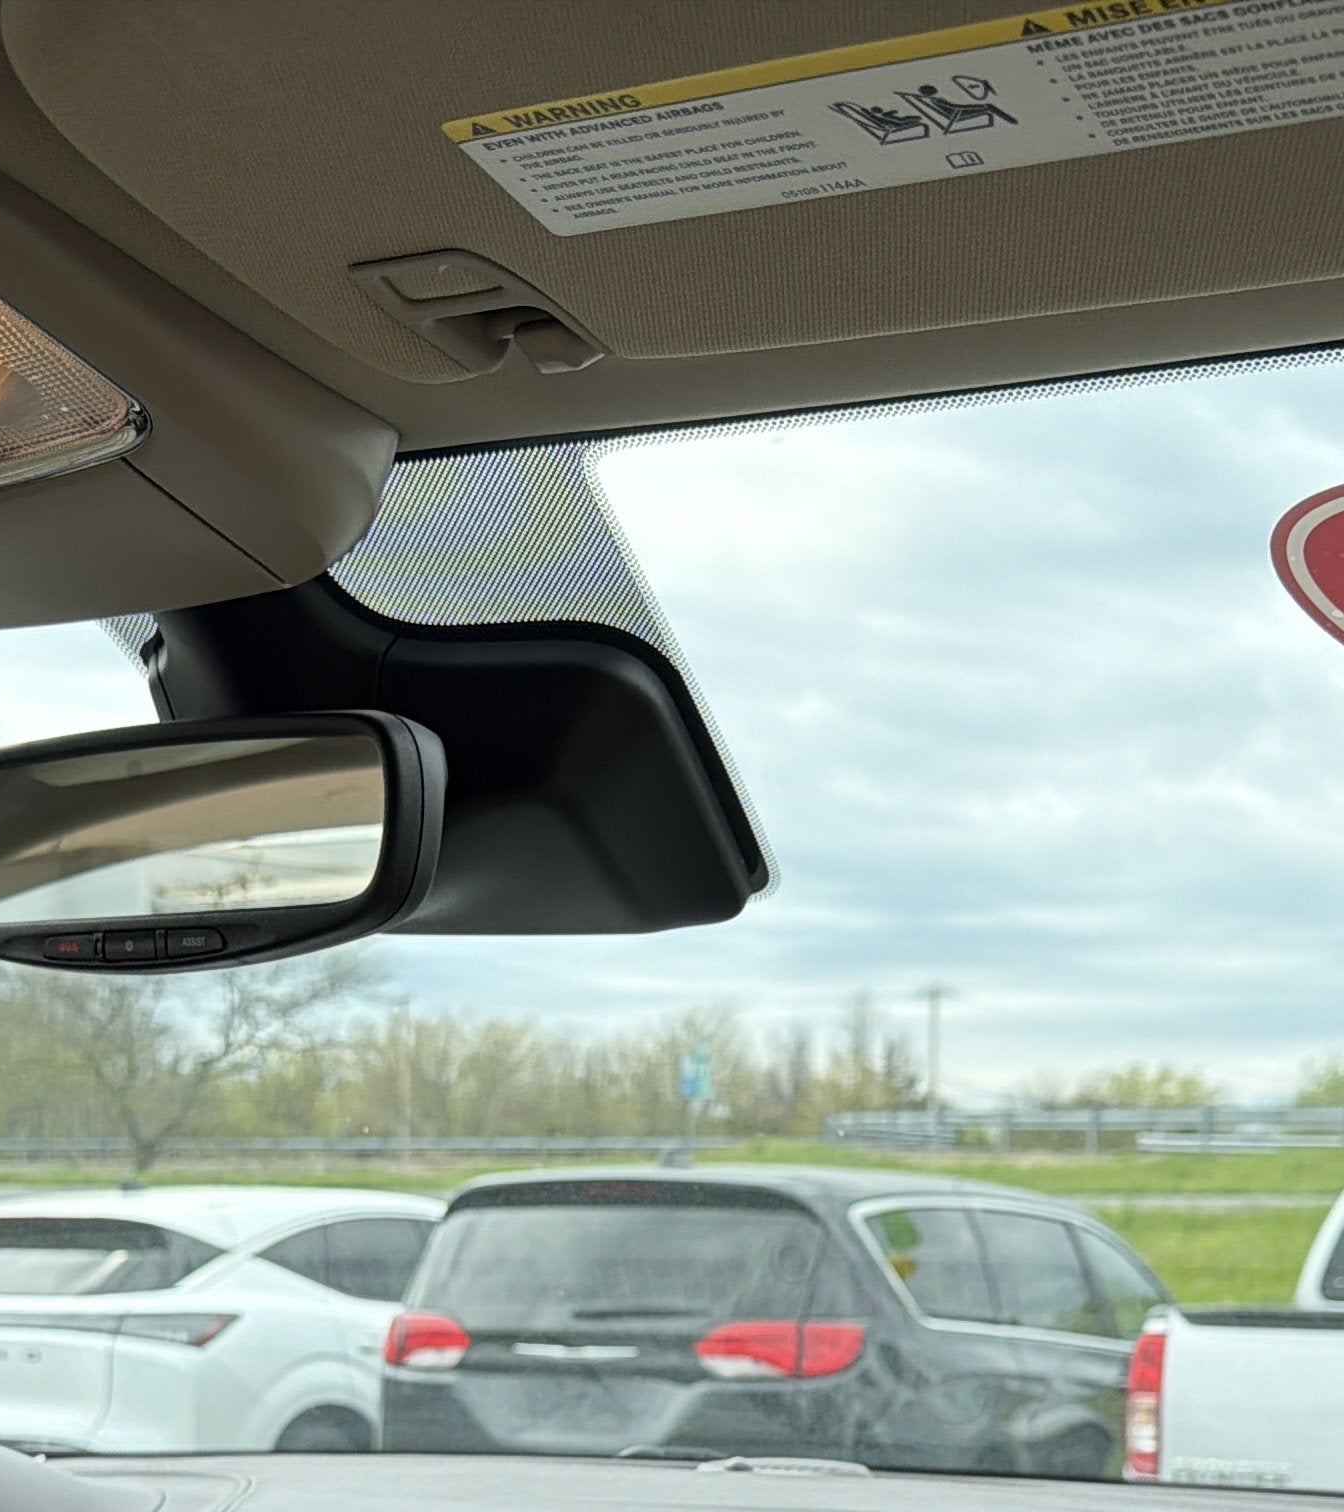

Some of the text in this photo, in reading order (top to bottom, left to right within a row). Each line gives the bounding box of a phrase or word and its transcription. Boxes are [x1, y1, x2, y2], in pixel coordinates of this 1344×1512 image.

[1024, 8, 1231, 54] MÊME AVEC DES SACS
[1063, 0, 1152, 26] MISE
[480, 101, 726, 151] EVEN WITH ADVANCED AIRBAGS
[501, 92, 644, 129] WARNING
[509, 109, 788, 162] CHILDREN CAN BE KILLED OR SERIOUSLY INJURED BY
[518, 161, 544, 170] THE
[529, 172, 555, 180] THE
[581, 162, 610, 172] SEAT
[620, 157, 645, 165] THE
[642, 150, 685, 162] SAFEST
[683, 144, 721, 155] PLACE
[719, 140, 744, 149] FOR
[541, 180, 580, 191] NEVER
[576, 177, 601, 185] PUT
[677, 158, 714, 169] CHILD
[712, 153, 744, 163] SEAT
[740, 151, 756, 159] IN
[753, 147, 780, 156] THE
[551, 190, 596, 201] ALWAYS
[672, 173, 700, 182] AND
[697, 167, 735, 178] CHILD
[631, 188, 679, 201] MANUAL
[677, 185, 702, 193] FOR
[700, 180, 735, 190] MORE
[733, 168, 811, 185] INFORMATION
[808, 161, 850, 173] ABOUT
[182, 937, 206, 947] ASSIST
